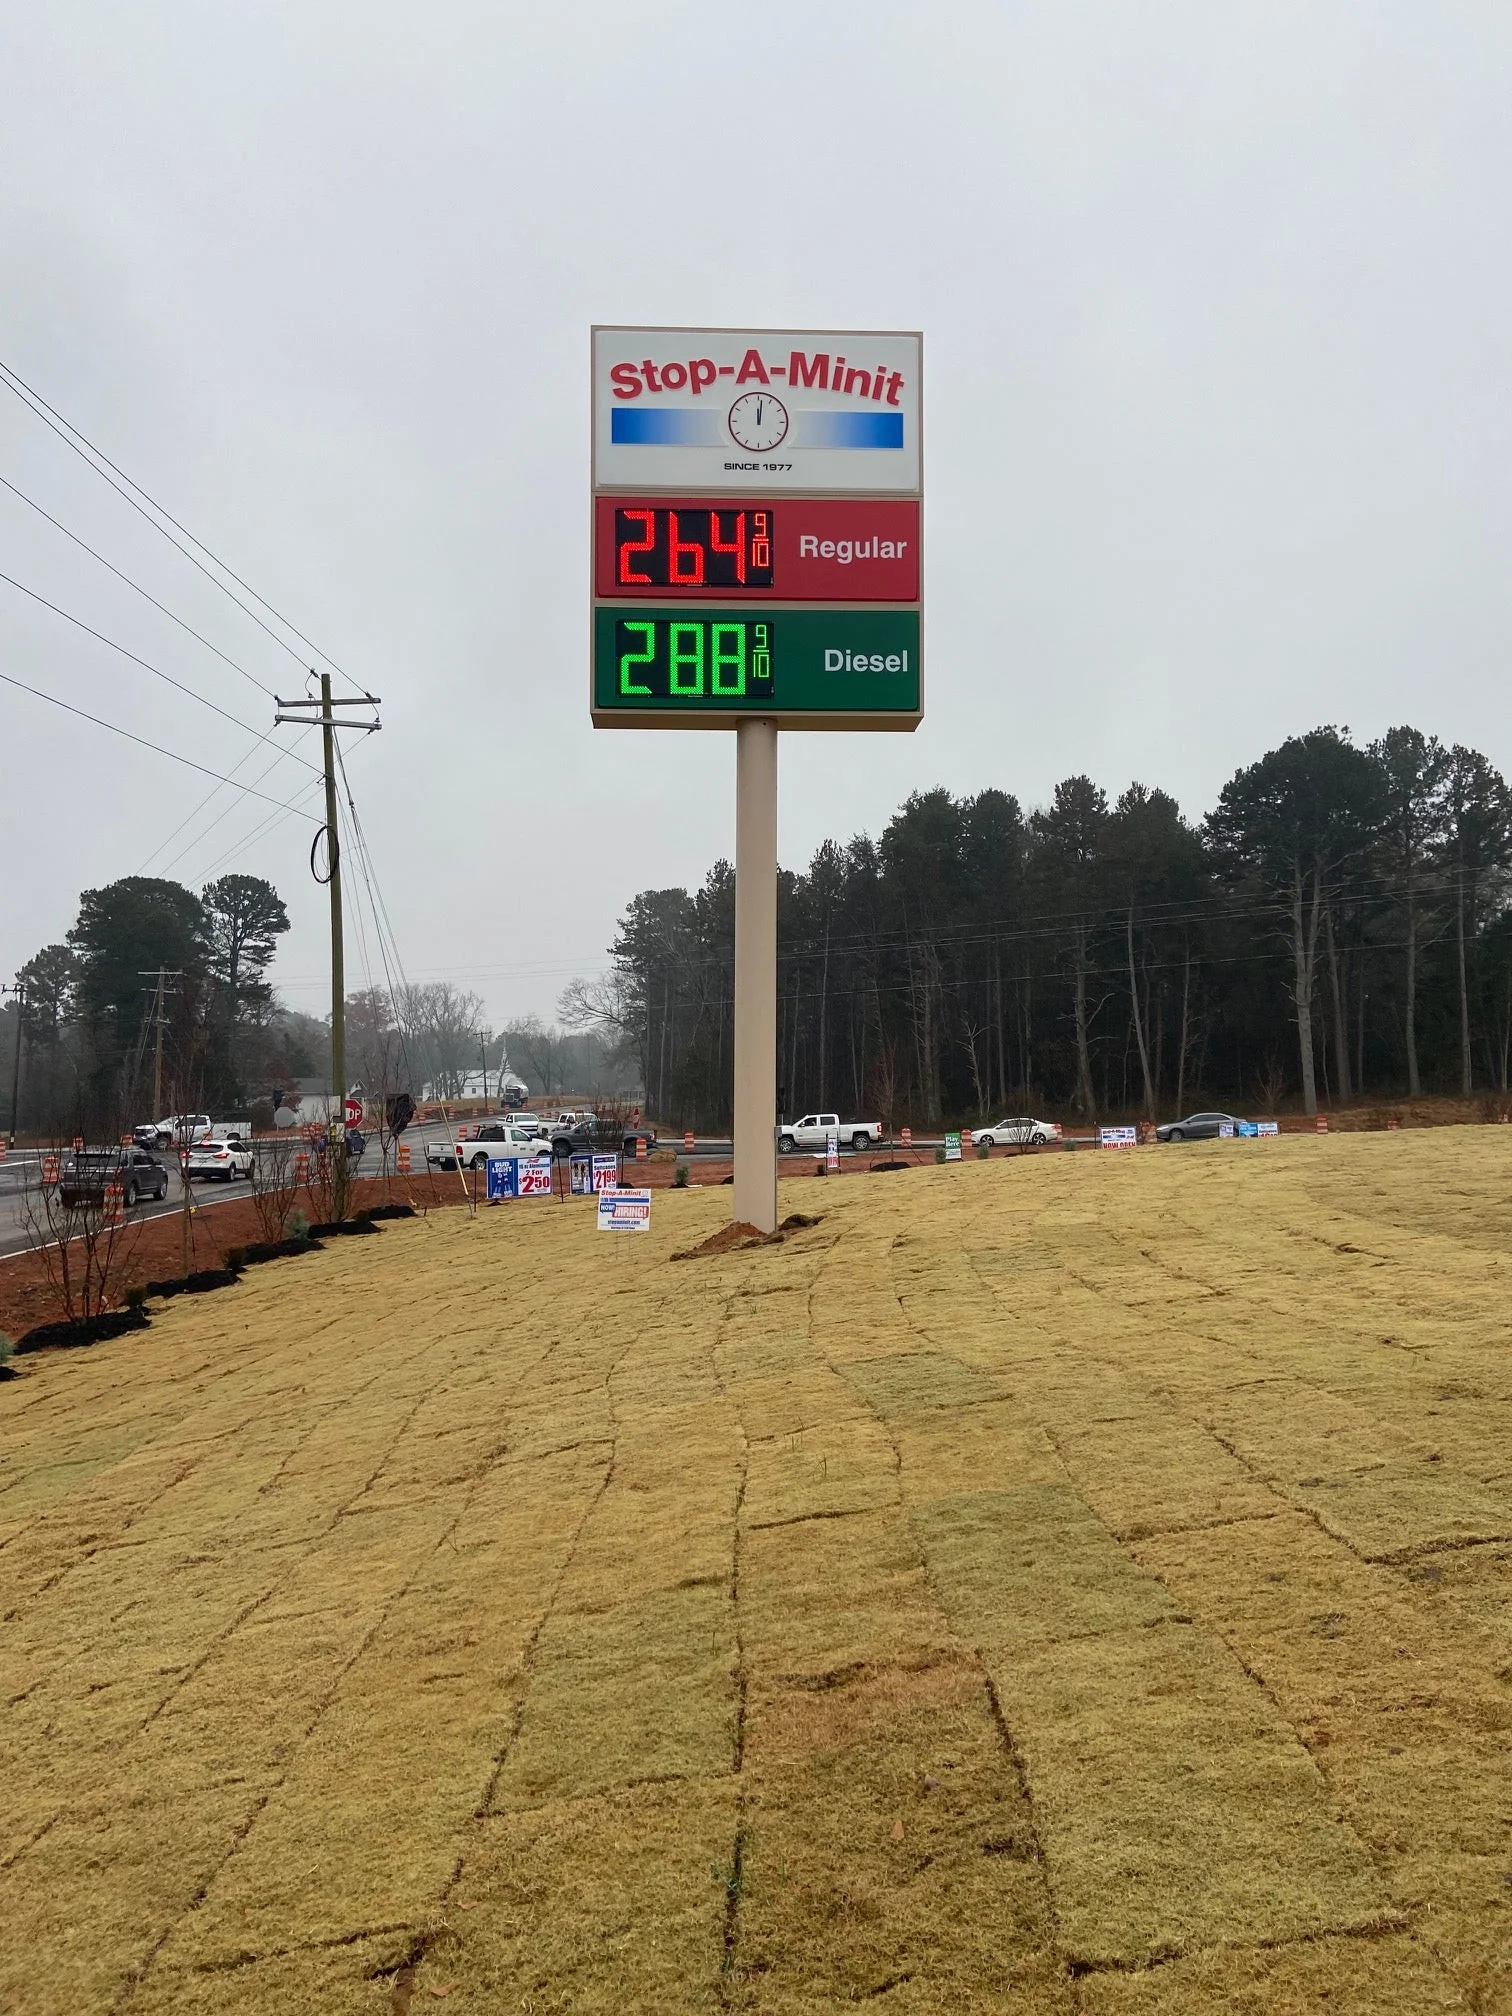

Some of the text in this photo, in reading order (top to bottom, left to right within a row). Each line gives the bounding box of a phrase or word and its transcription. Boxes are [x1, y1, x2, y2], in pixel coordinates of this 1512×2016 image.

[610, 349, 904, 405] Stop-A-Minit
[724, 462, 793, 472] SINCE 1977
[800, 535, 907, 564] Regular
[824, 649, 908, 672] Diesel
[615, 1206, 647, 1217] HIRING!
